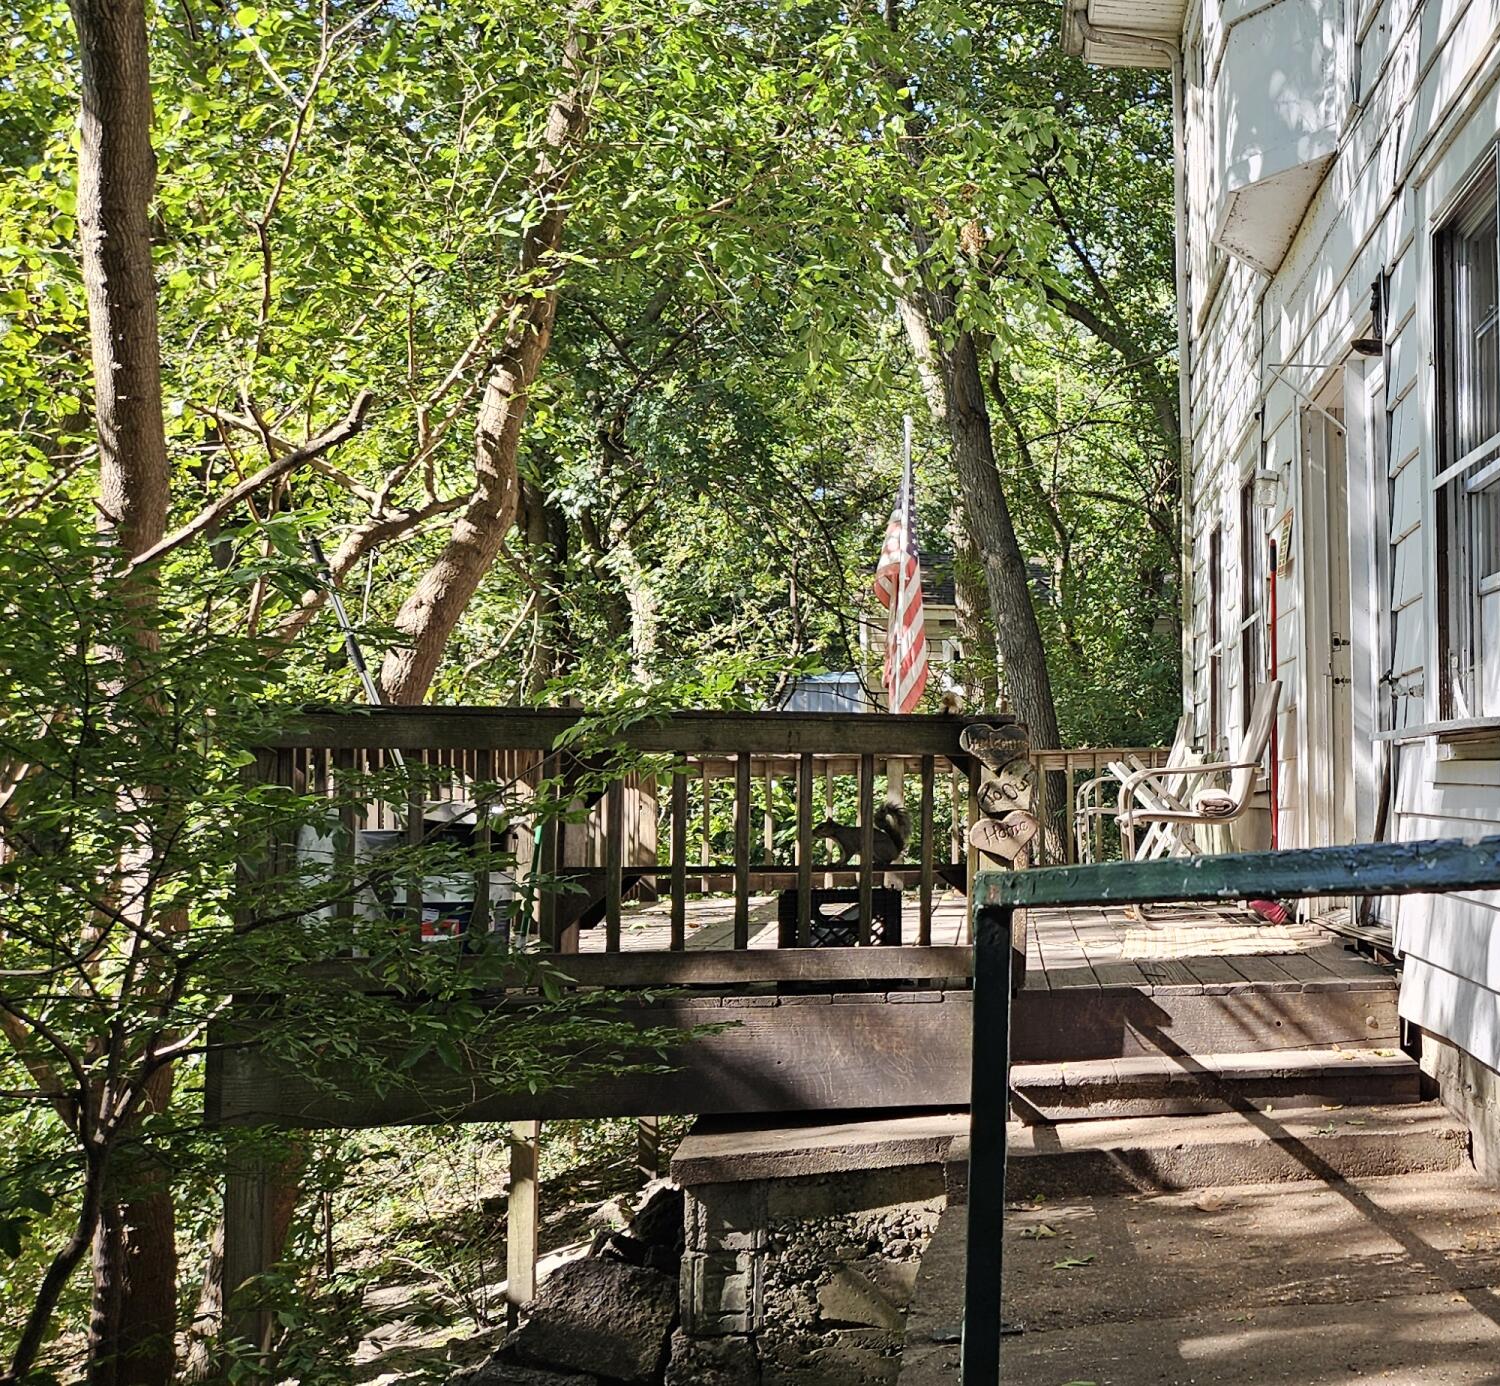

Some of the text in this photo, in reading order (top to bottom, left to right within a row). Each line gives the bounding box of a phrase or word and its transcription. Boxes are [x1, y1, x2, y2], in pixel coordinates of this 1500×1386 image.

[984, 774, 1029, 806] To Our
[984, 820, 1030, 846] Home
